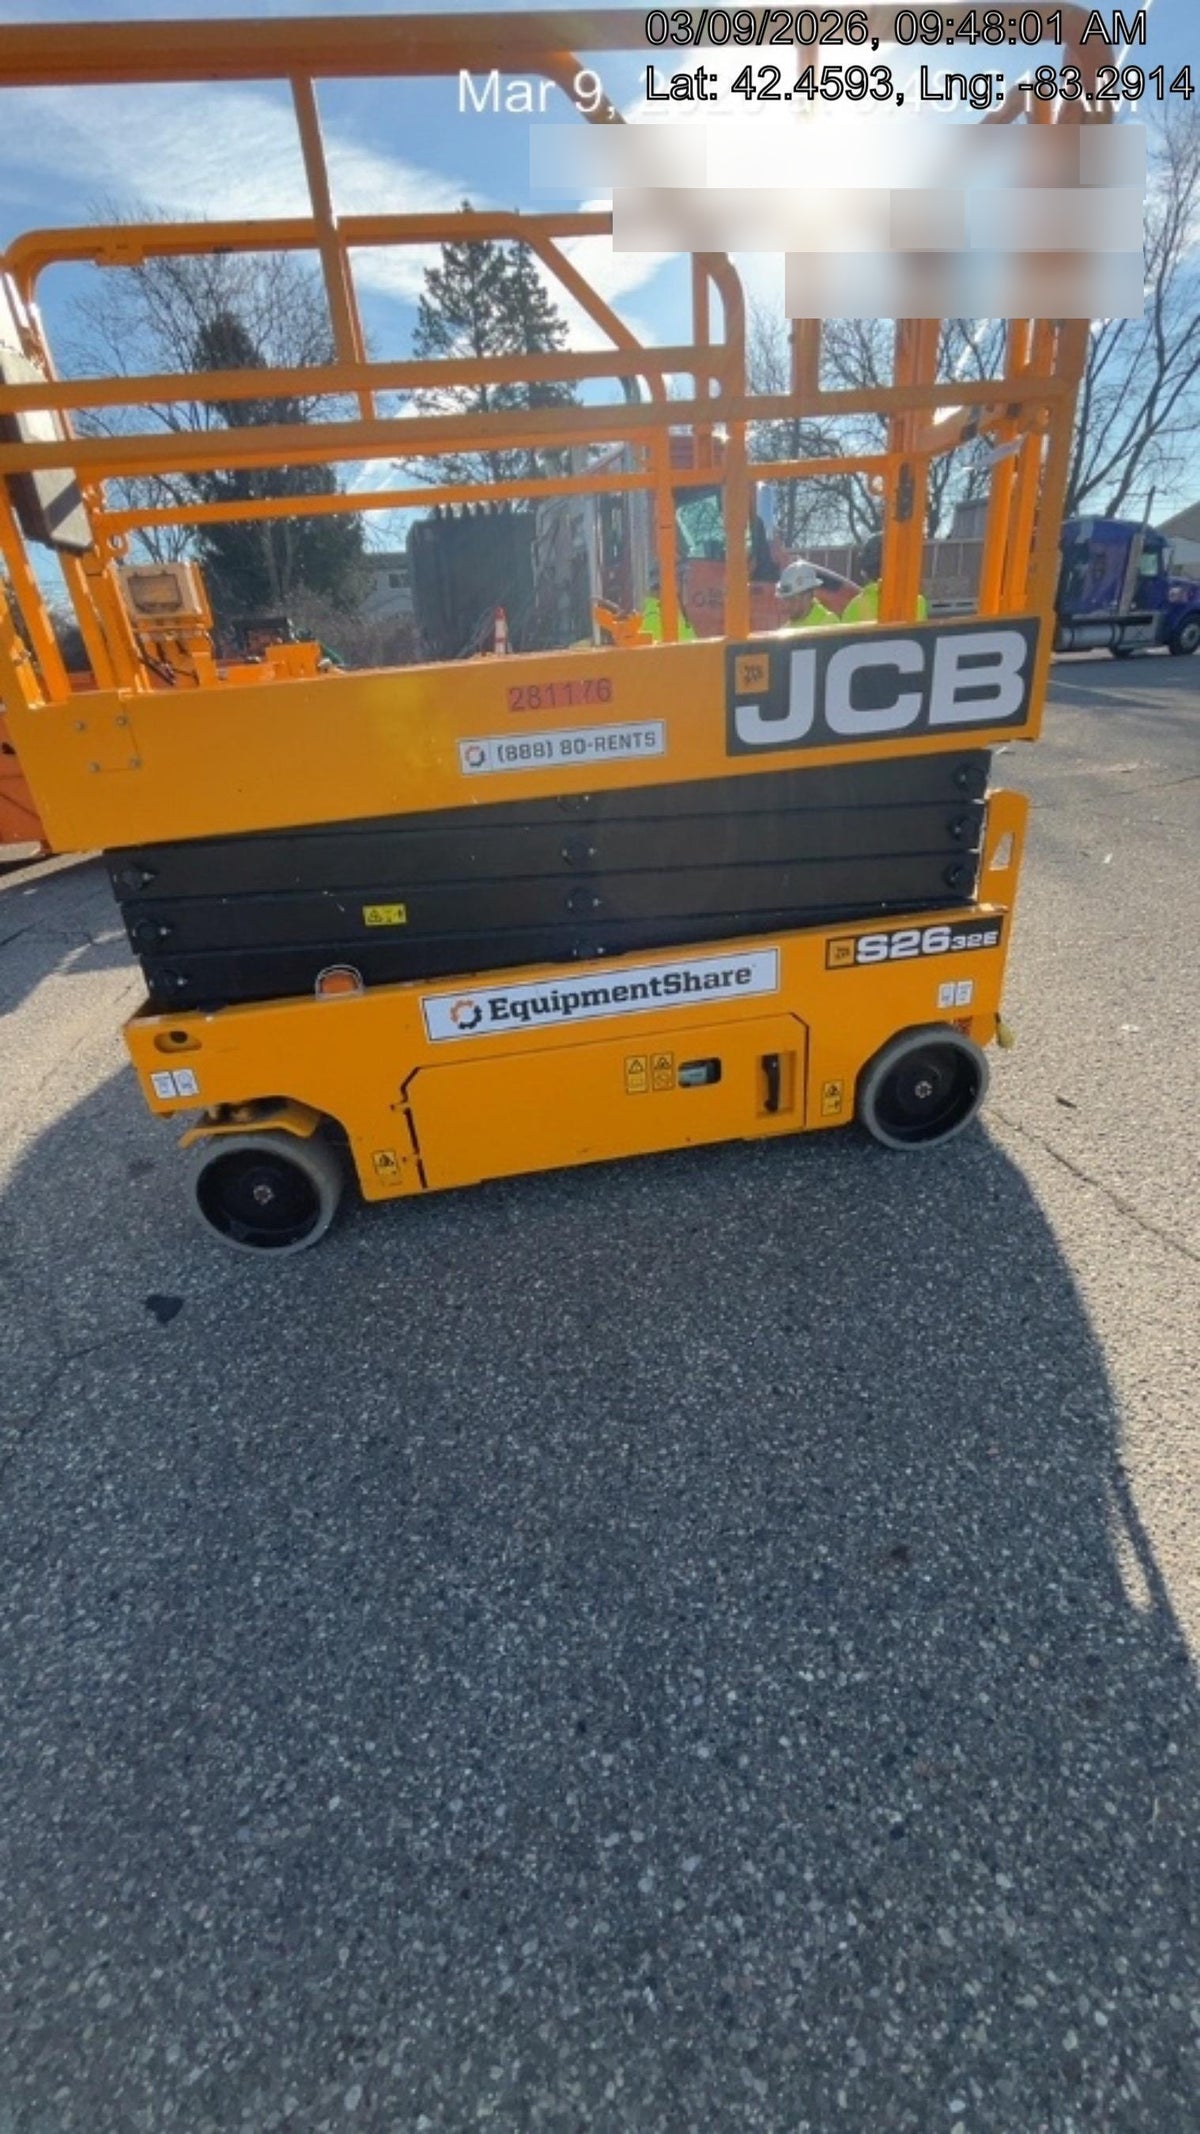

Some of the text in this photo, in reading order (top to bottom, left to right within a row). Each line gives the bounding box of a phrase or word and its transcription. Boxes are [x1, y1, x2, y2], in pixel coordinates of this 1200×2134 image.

[509, 678, 613, 712] 281176
[735, 630, 1028, 744] JCB
[497, 731, 656, 763] (888) 80-RENTS
[488, 966, 752, 1021] EquipmentShare
